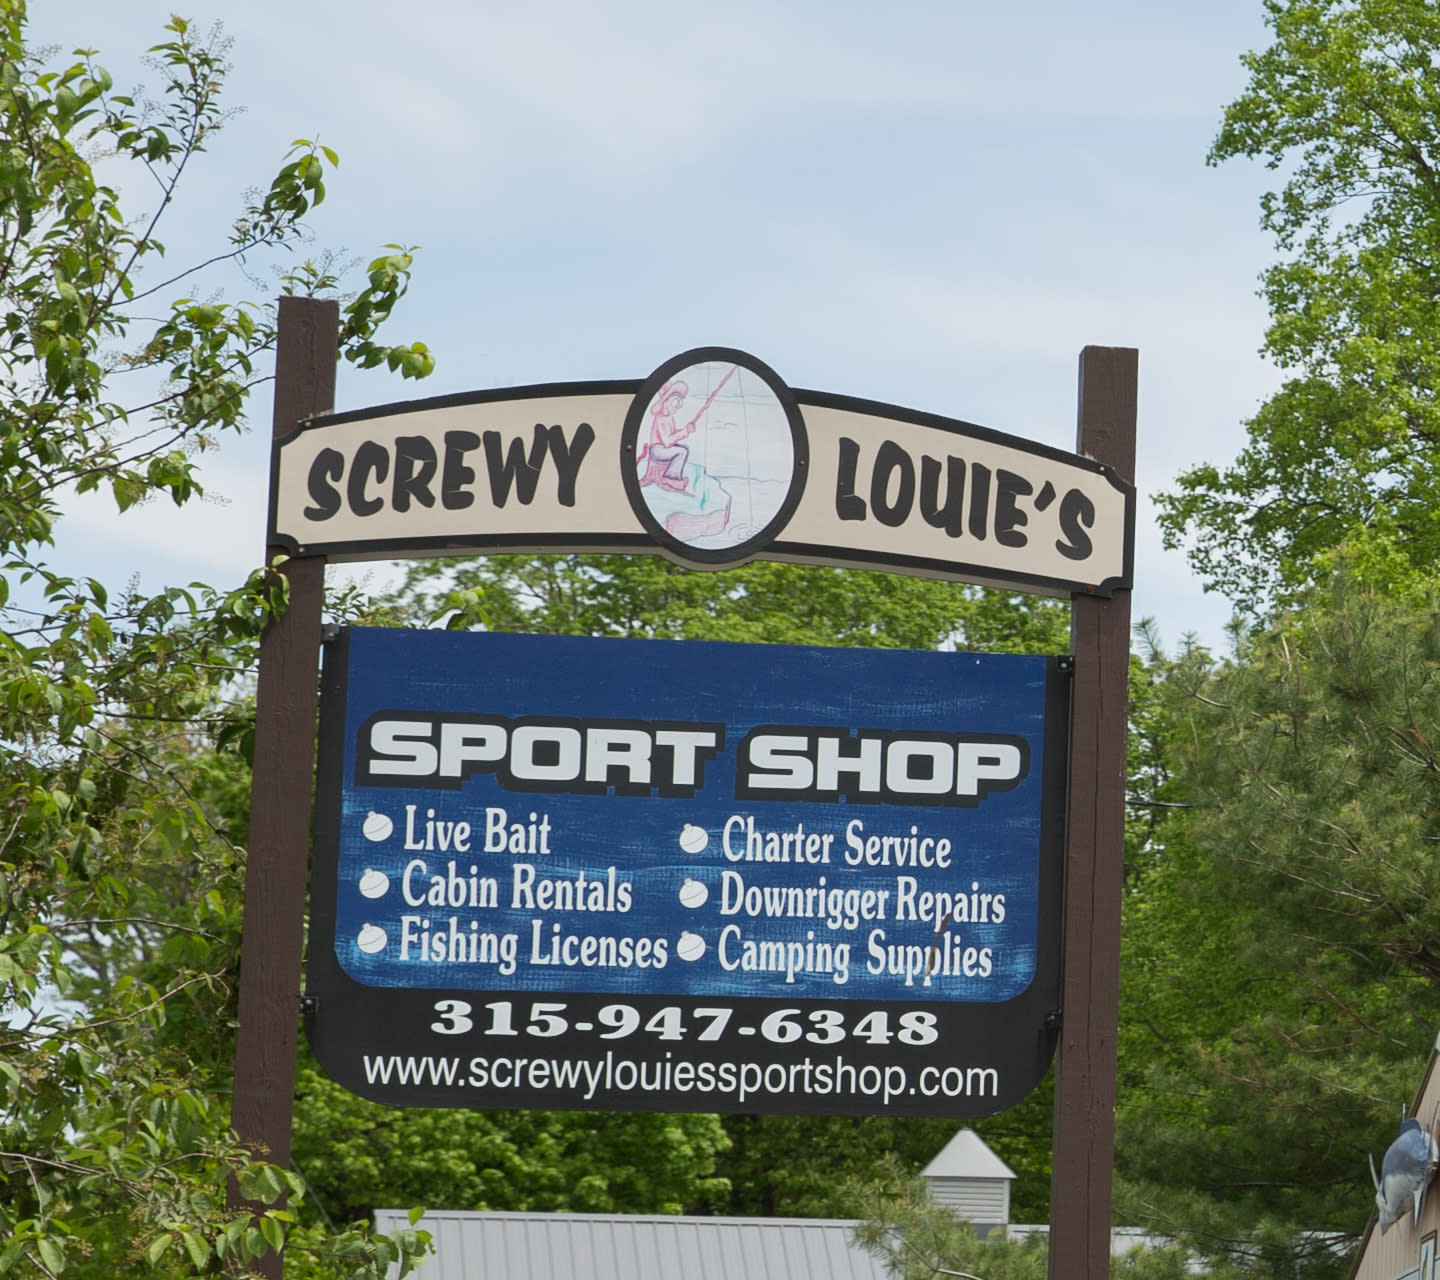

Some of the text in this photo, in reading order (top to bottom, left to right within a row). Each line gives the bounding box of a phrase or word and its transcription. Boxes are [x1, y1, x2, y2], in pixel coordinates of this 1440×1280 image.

[305, 422, 1097, 562] SCREWY LOUIE'S
[369, 720, 1021, 797] SPORT SHOP
[403, 805, 551, 857] Live Bait
[722, 815, 952, 869] Charter Service
[401, 859, 633, 914] Cabin Rentals
[720, 871, 1006, 933] Downrigger Repairs
[400, 915, 668, 974] Fishing Licenses
[717, 924, 993, 986] Camping Supplies
[431, 1000, 939, 1046] 315-947-6348
[363, 1050, 998, 1104] www.screwylouiessportshop.com
